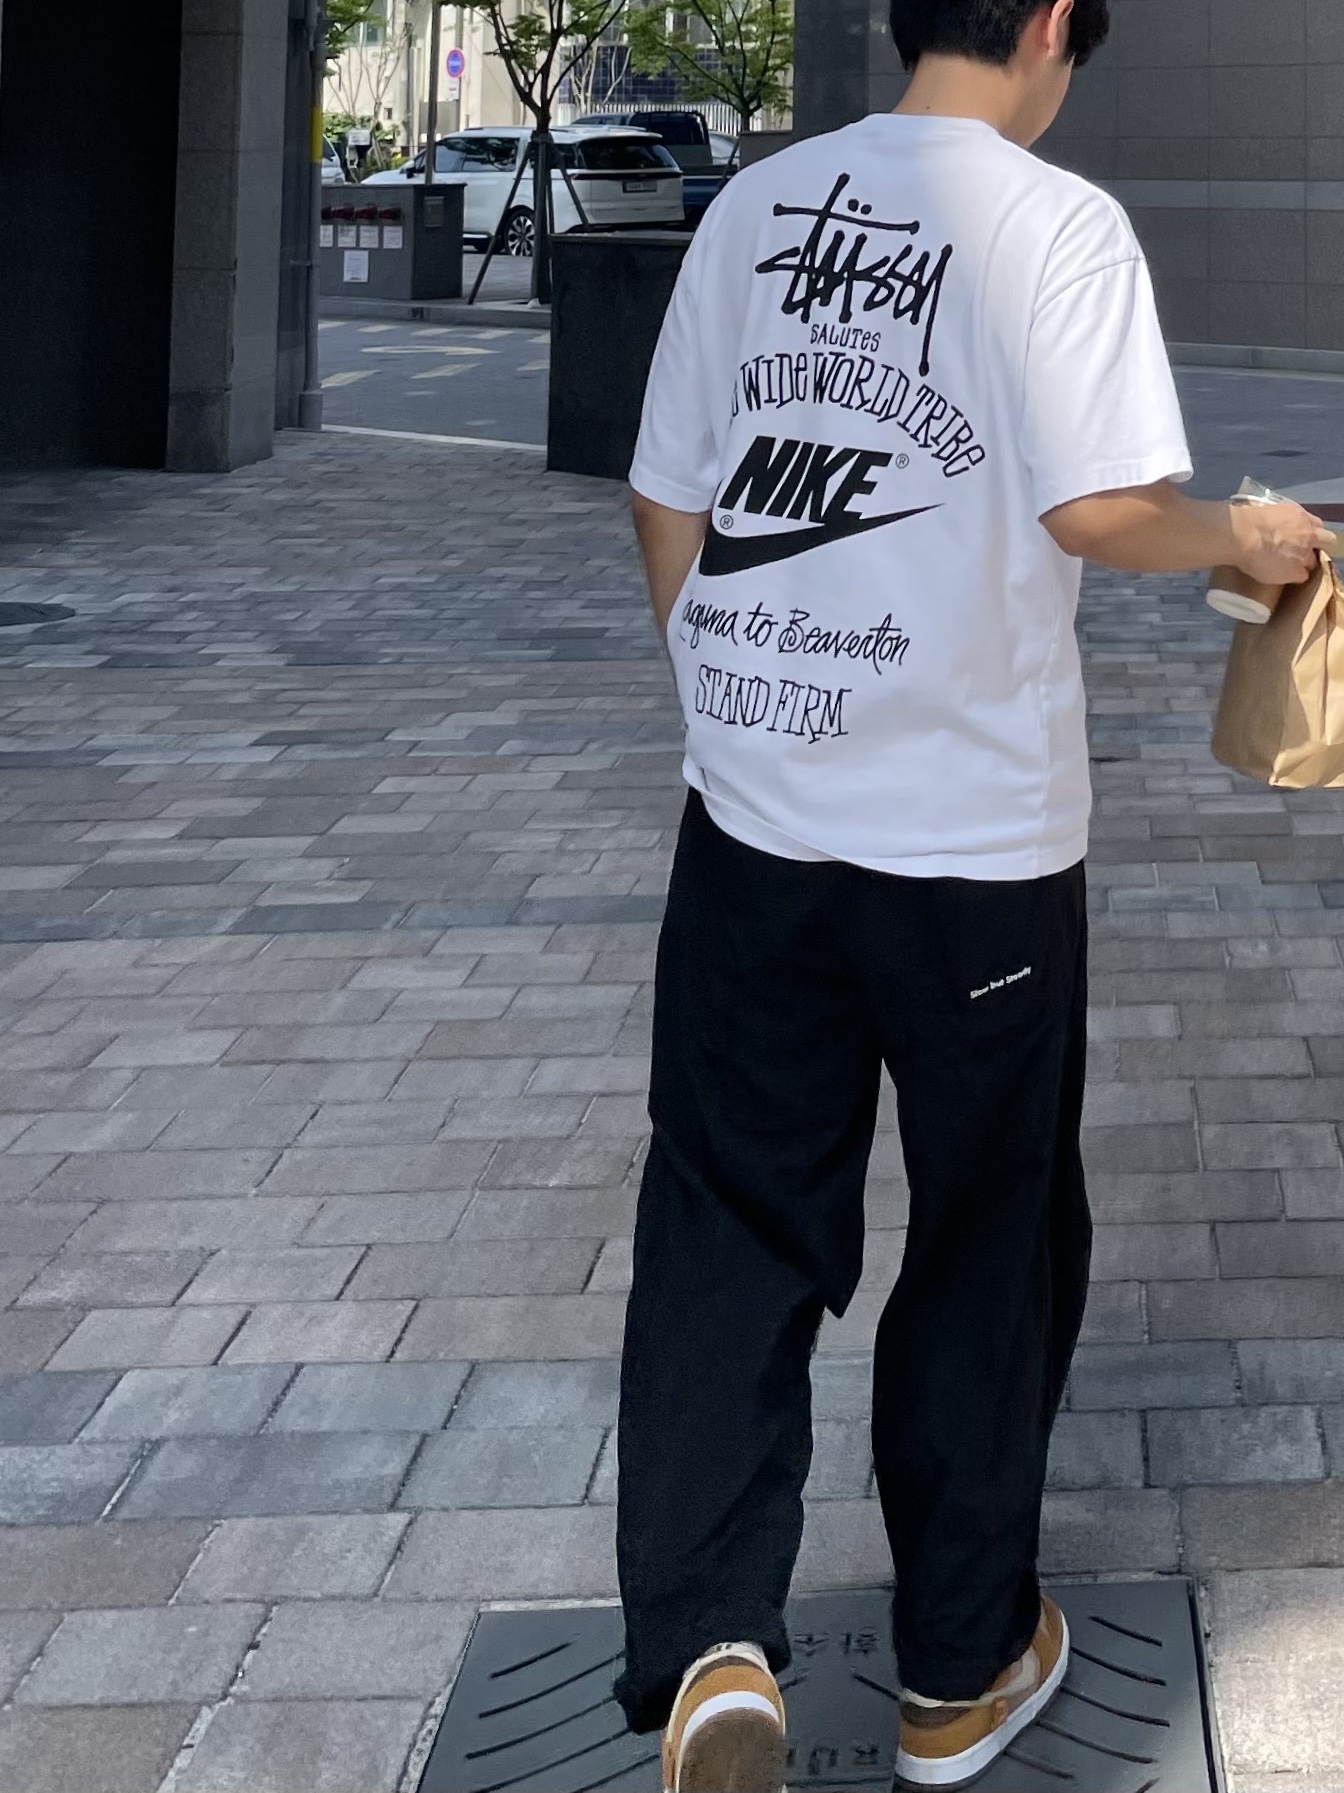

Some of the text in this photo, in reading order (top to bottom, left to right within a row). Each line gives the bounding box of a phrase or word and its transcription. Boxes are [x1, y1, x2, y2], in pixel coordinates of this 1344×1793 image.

[812, 351, 910, 423] WORLD
[717, 435, 894, 523] NIKE
[742, 601, 779, 647] to
[778, 608, 911, 676] Beaverton
[695, 664, 853, 744] STAND FIRM
